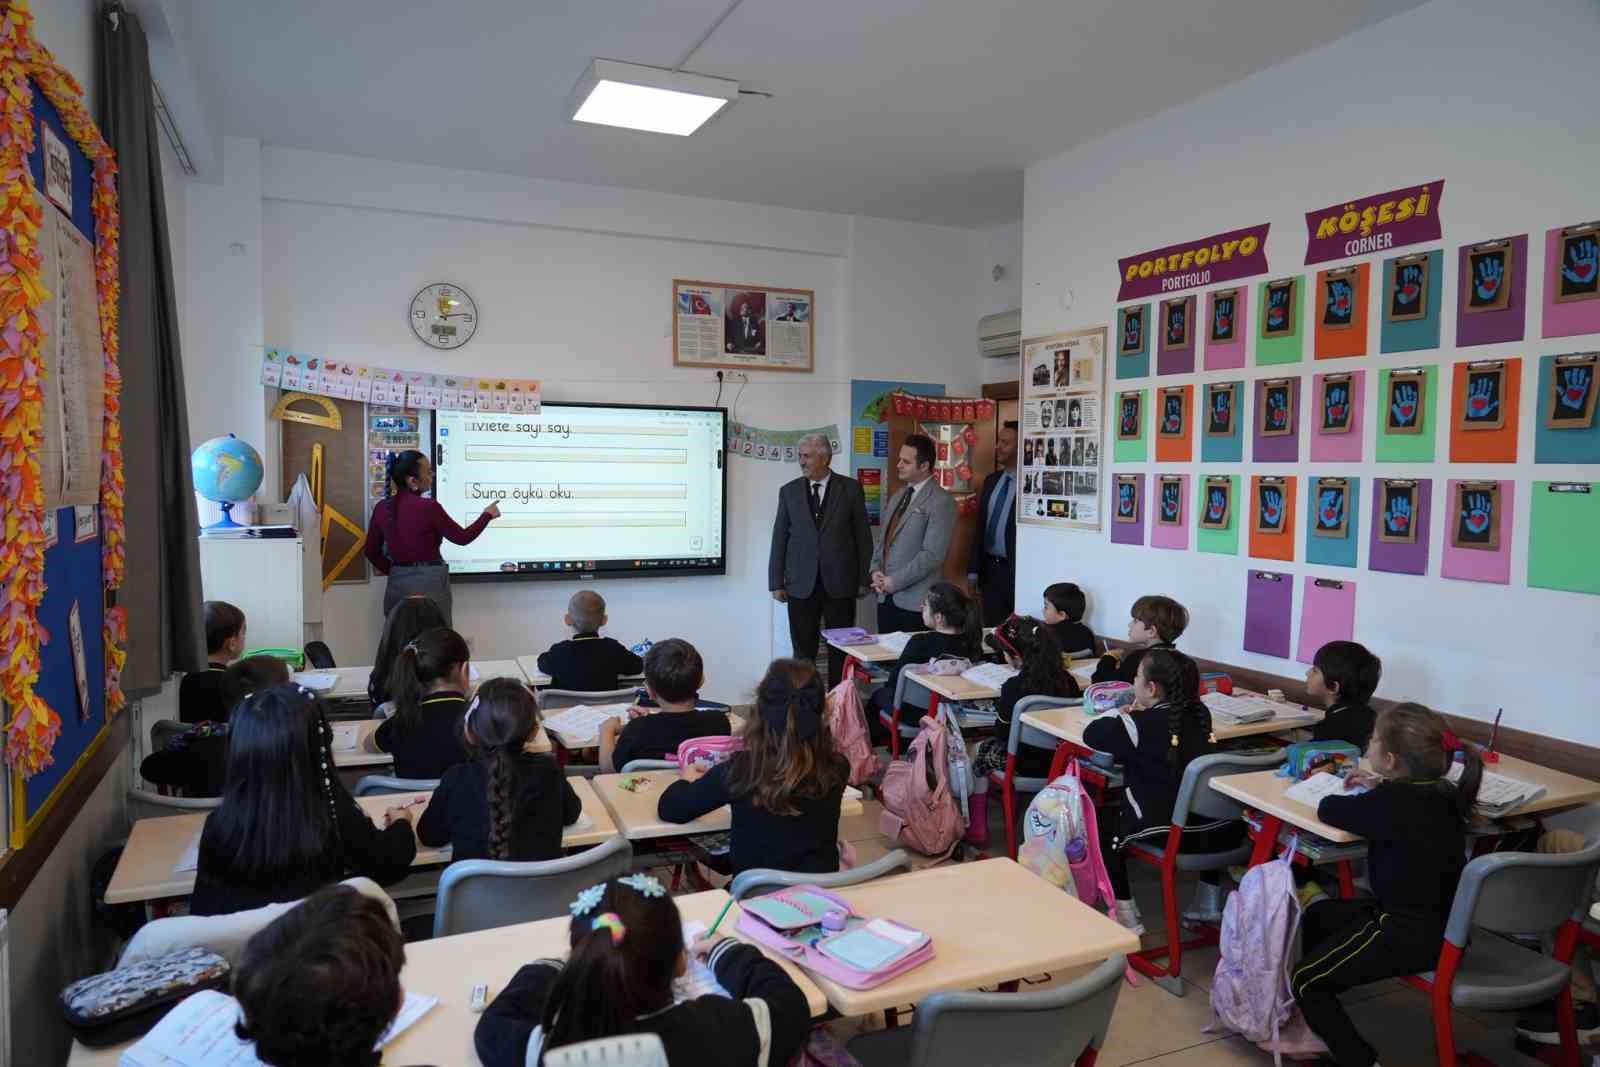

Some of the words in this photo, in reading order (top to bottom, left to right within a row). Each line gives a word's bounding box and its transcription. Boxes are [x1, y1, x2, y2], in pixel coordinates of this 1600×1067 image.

[1316, 185, 1431, 237] KÖŞESİ
[1344, 232, 1393, 257] CORNER
[1125, 235, 1259, 282] PORTFOLYO
[1161, 270, 1211, 291] PORTFOLIO
[743, 443, 753, 454] 2
[757, 446, 765, 457] 3
[771, 447, 779, 458] 4
[786, 448, 793, 458] 5
[472, 482, 507, 499] Suna
[512, 482, 543, 504] öykü
[549, 482, 575, 499] oku.
